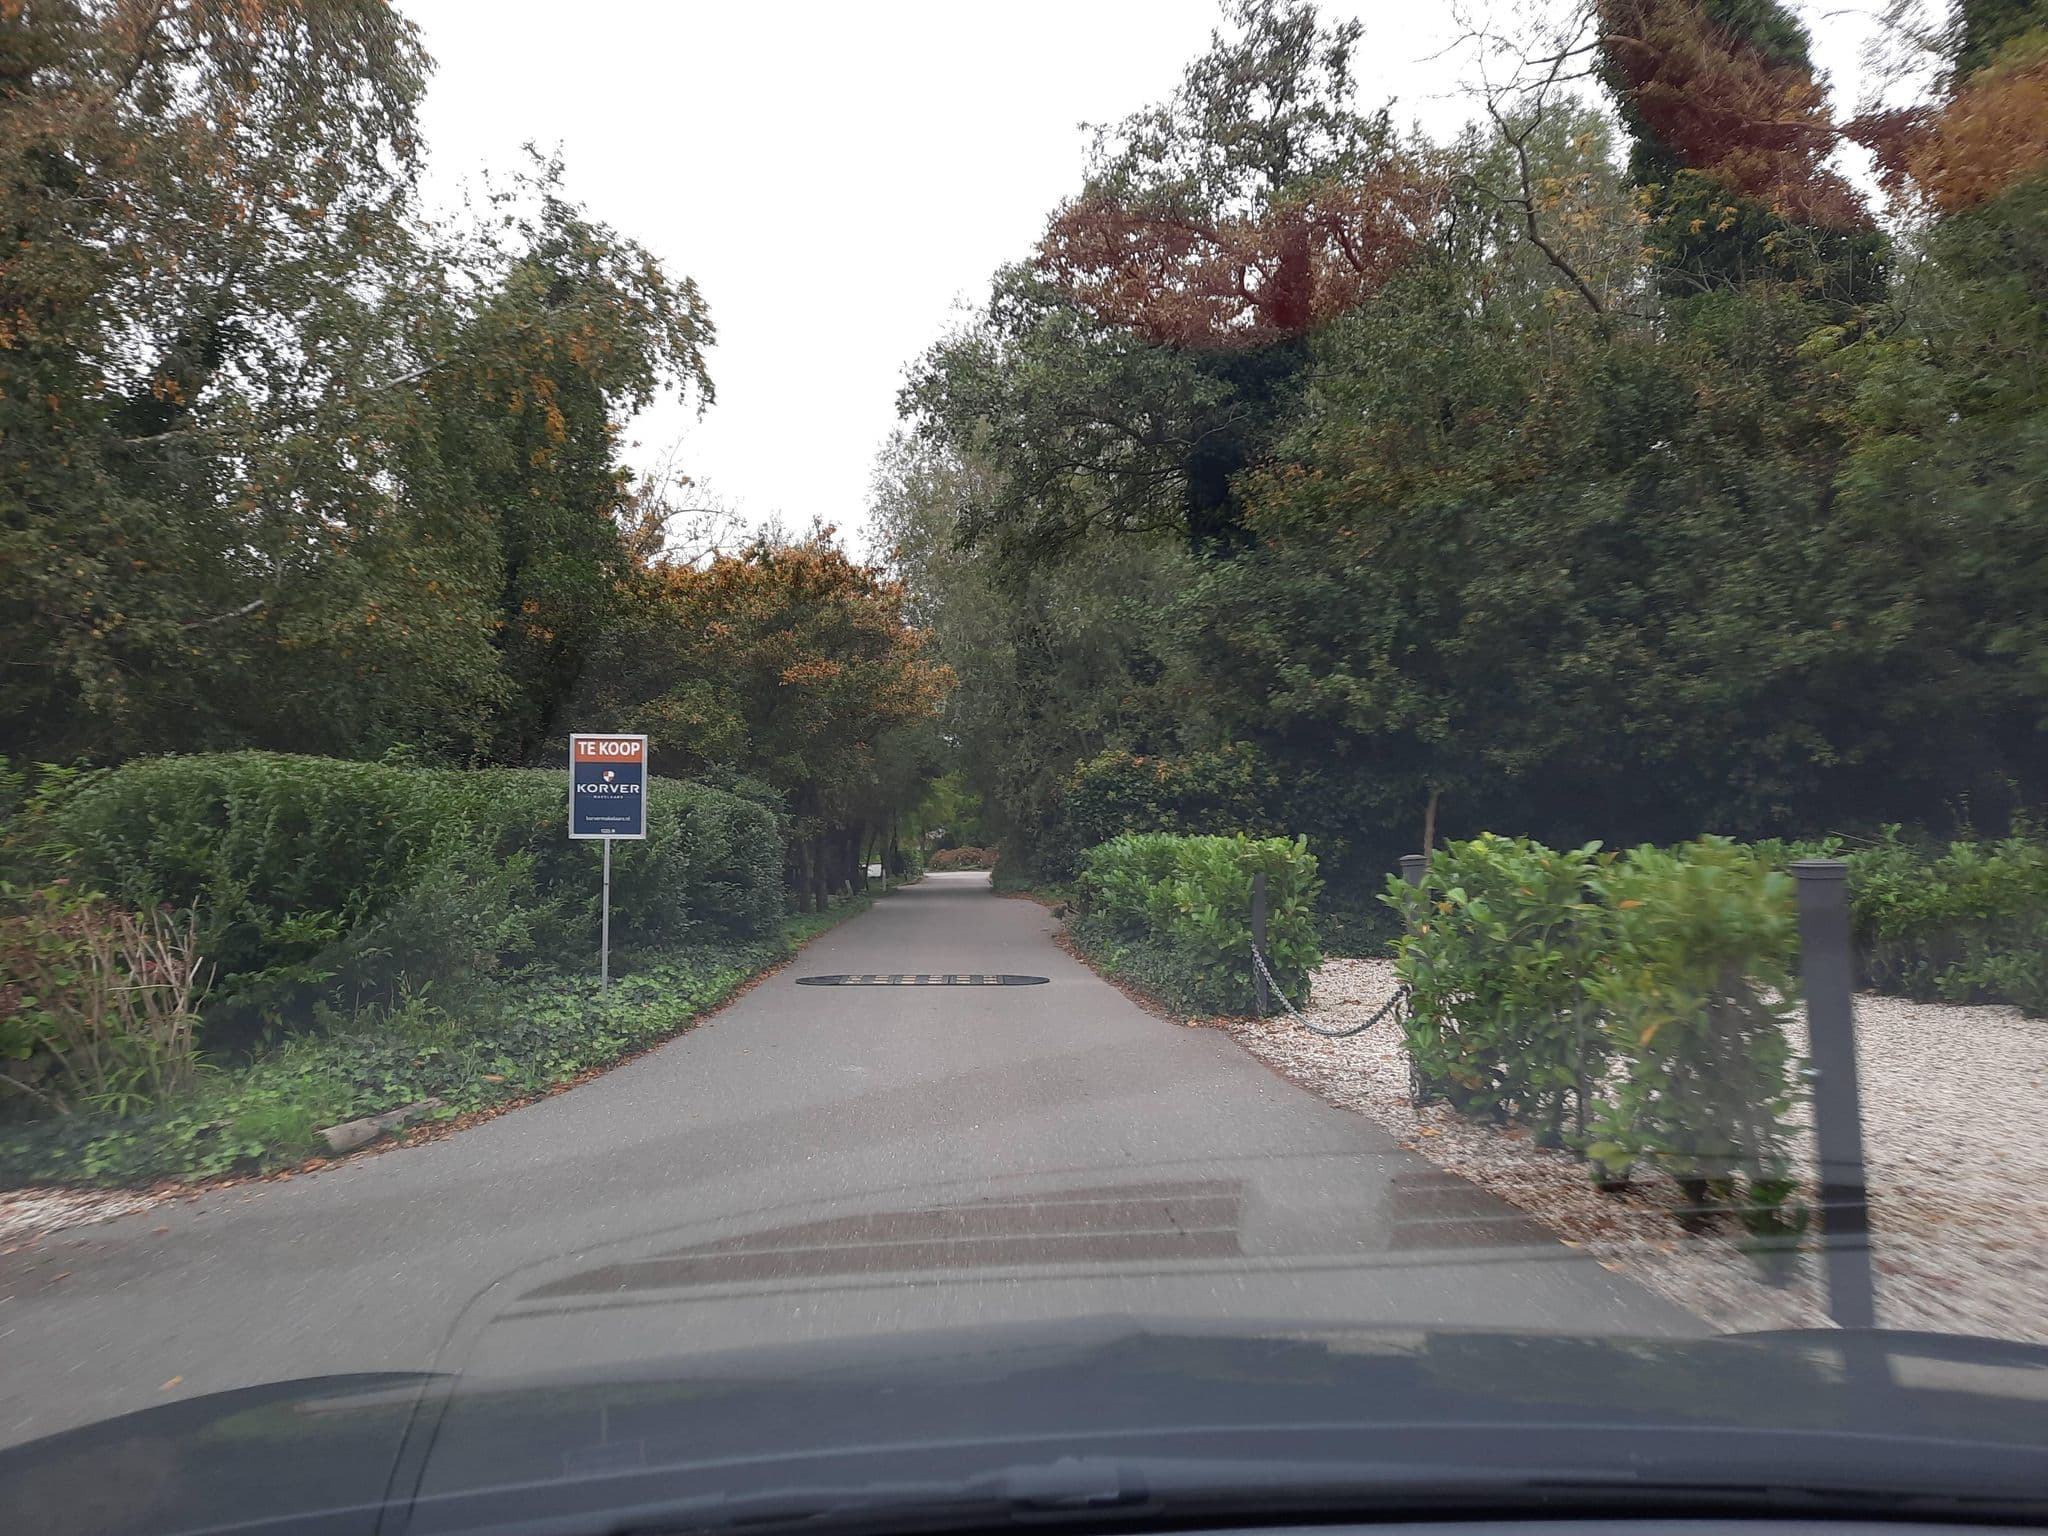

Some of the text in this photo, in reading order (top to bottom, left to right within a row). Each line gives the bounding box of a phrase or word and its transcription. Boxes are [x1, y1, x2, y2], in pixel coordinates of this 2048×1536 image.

[578, 741, 641, 756] TE KOOP
[577, 784, 640, 793] KORVER
